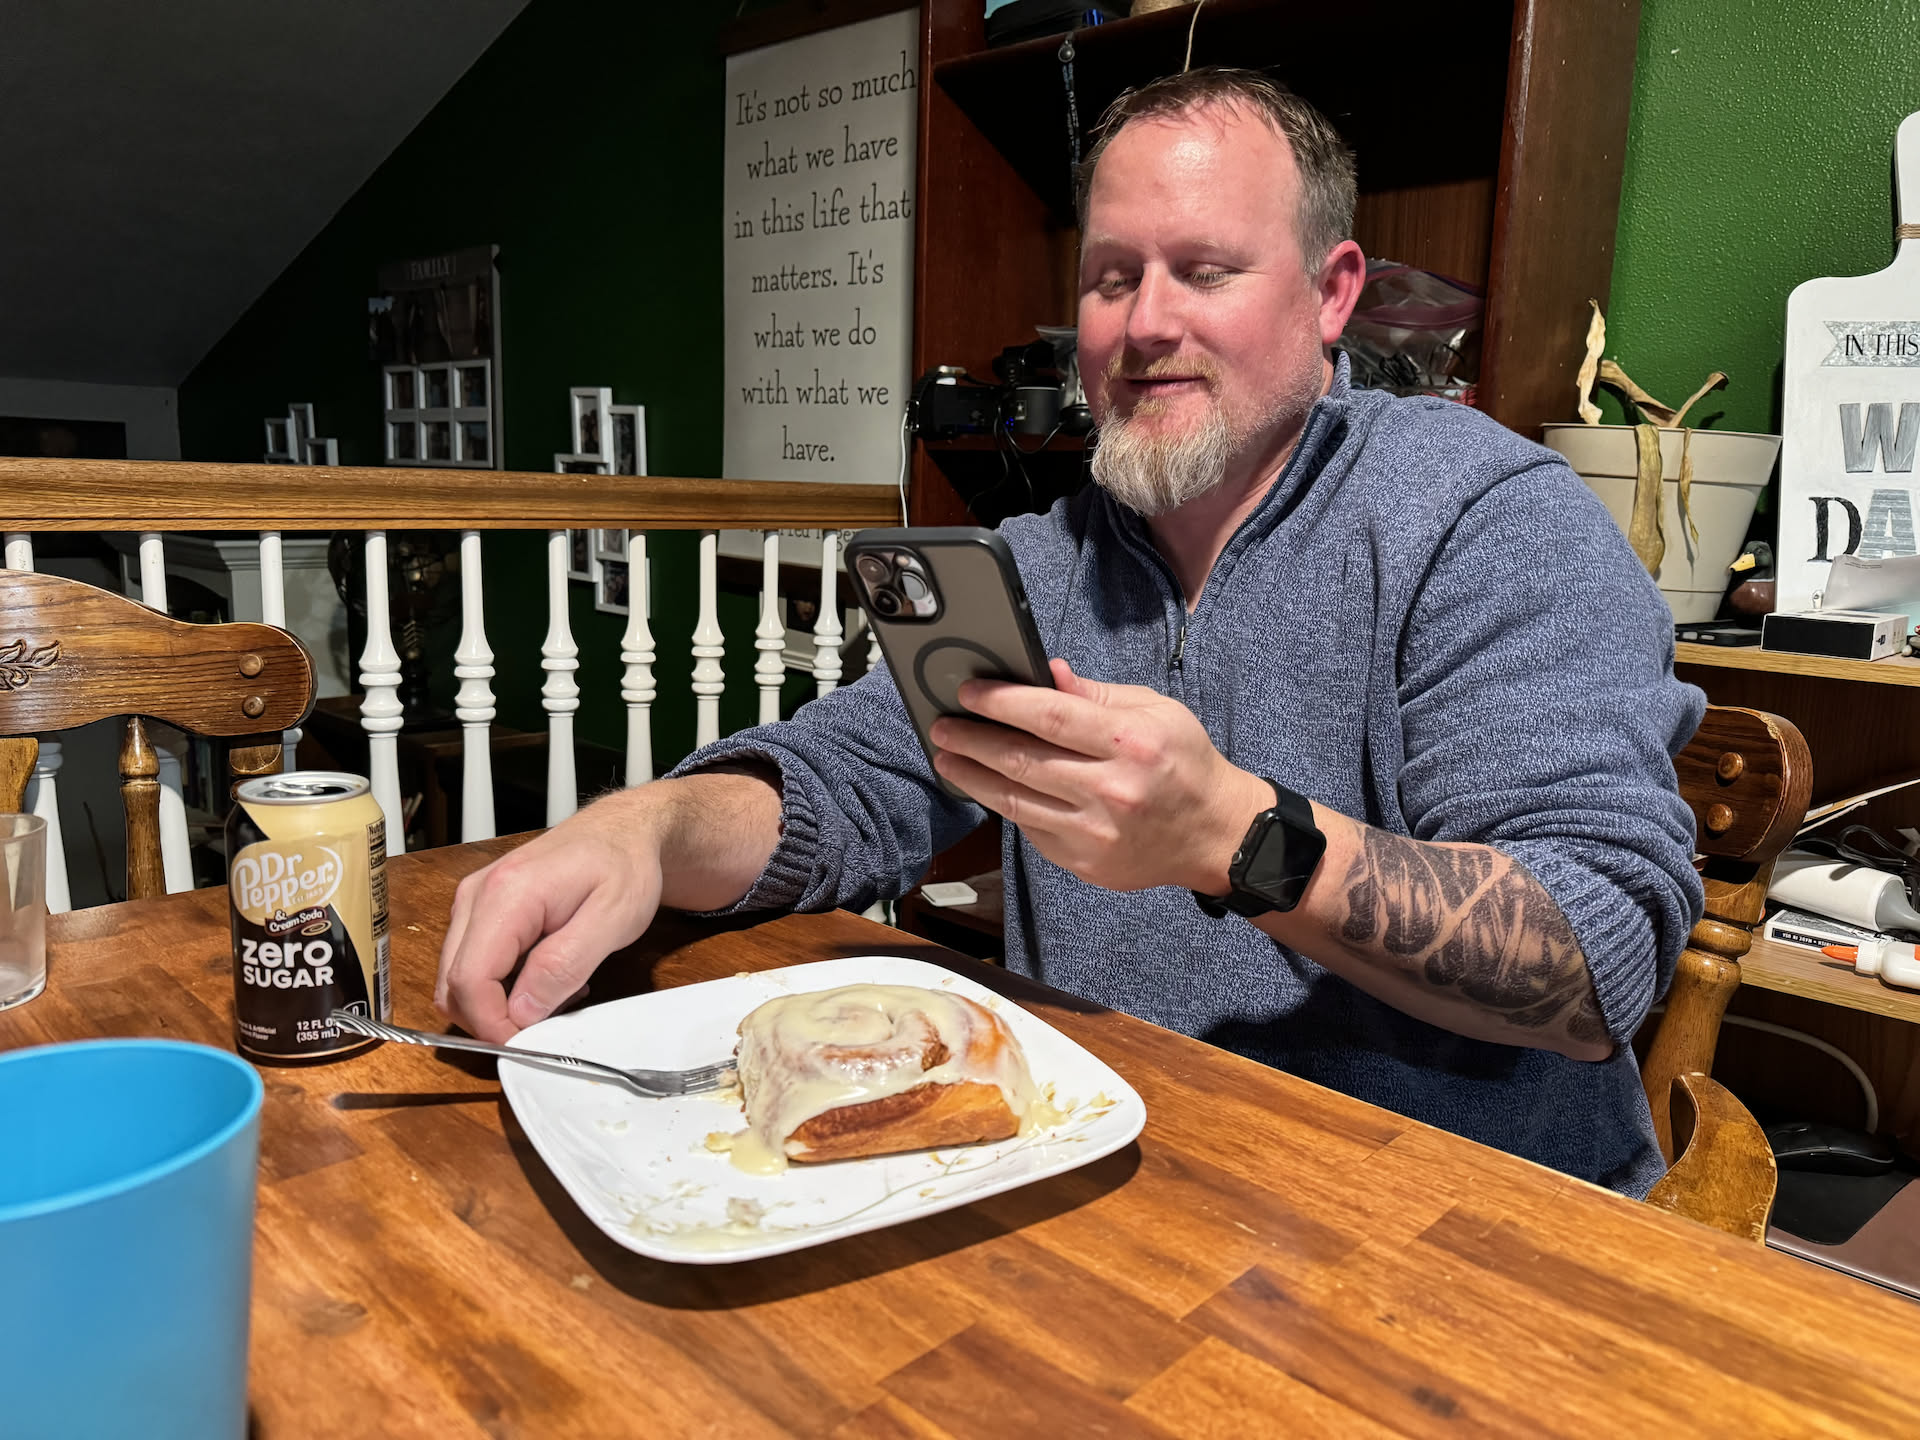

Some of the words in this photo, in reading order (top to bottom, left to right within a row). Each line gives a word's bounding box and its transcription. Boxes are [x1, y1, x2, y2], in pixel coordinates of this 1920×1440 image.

[735, 90, 767, 126] It's
[774, 85, 810, 118] not
[818, 85, 843, 109] so
[852, 50, 917, 101] much
[747, 141, 798, 180] what
[806, 147, 835, 168] we
[843, 125, 899, 164] have
[734, 211, 754, 239] in
[762, 198, 805, 236] this
[812, 187, 851, 229] life
[860, 182, 912, 225] that
[751, 264, 838, 293] matters.
[847, 248, 884, 286] It's
[754, 313, 805, 349] what
[812, 327, 841, 347] we
[848, 308, 877, 346] do
[1845, 334, 1865, 356] IN
[1872, 334, 1920, 356] THIS
[742, 370, 789, 406] with
[796, 369, 849, 406] what
[857, 385, 889, 406] we
[782, 425, 836, 463] have.
[1839, 403, 1920, 473] W
[1807, 489, 1918, 563] DA
[239, 857, 334, 912] Pepper
[260, 852, 303, 884] Dr
[269, 916, 301, 933] Cream
[300, 908, 324, 924] Soda
[275, 909, 288, 921] &
[242, 938, 334, 969] zero
[243, 966, 335, 989] SUGAR
[296, 1029, 320, 1044] (355
[321, 1026, 341, 1040] mL)
[297, 1020, 310, 1032] 12
[311, 1019, 325, 1030] FL
